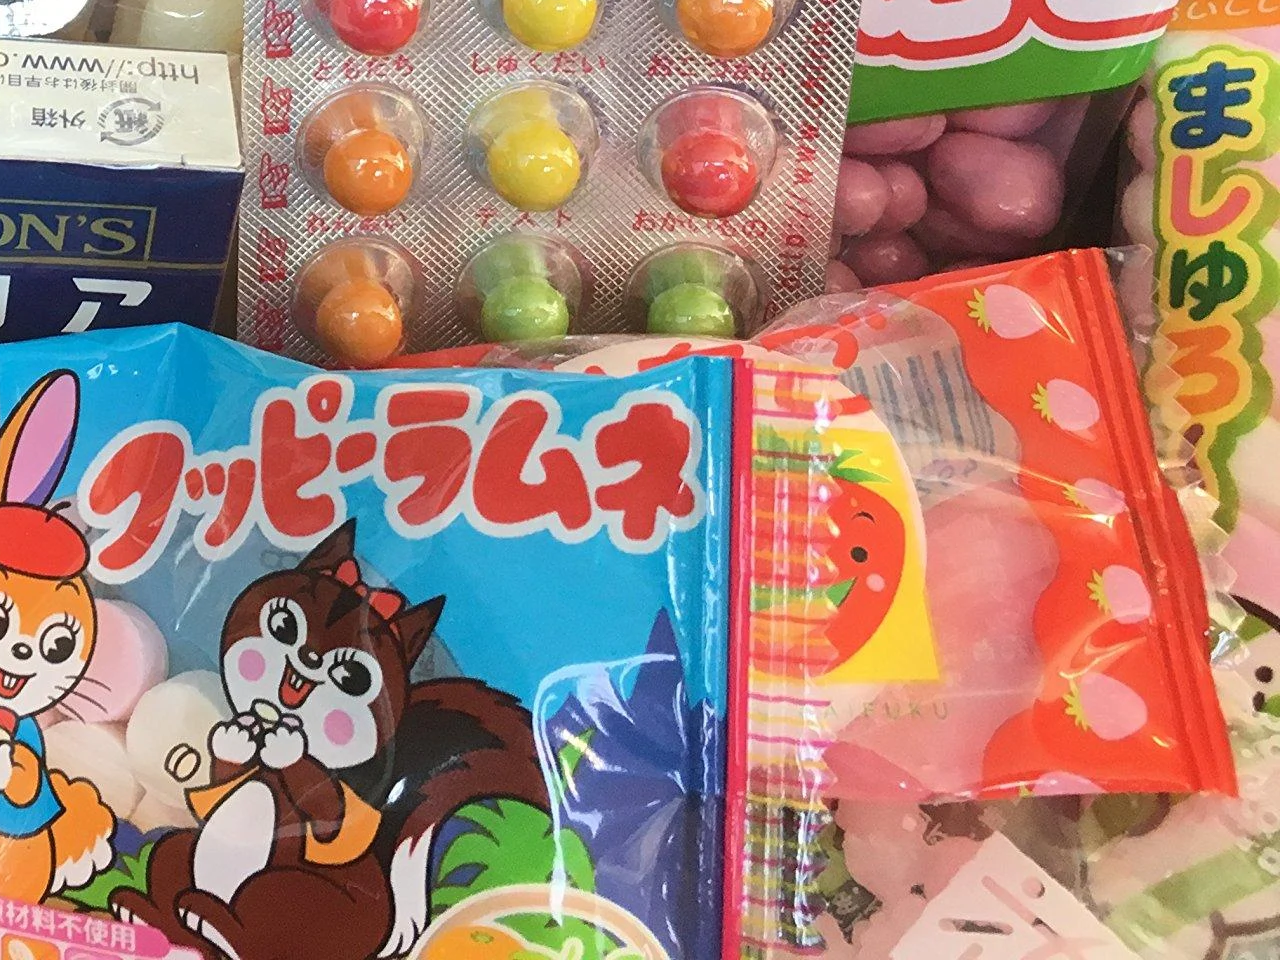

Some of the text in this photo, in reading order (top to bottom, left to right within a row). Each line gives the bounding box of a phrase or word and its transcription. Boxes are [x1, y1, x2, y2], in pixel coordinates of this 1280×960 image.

[30, 105, 87, 131] 外箱
[84, 375, 700, 578] クッピーラムネ
